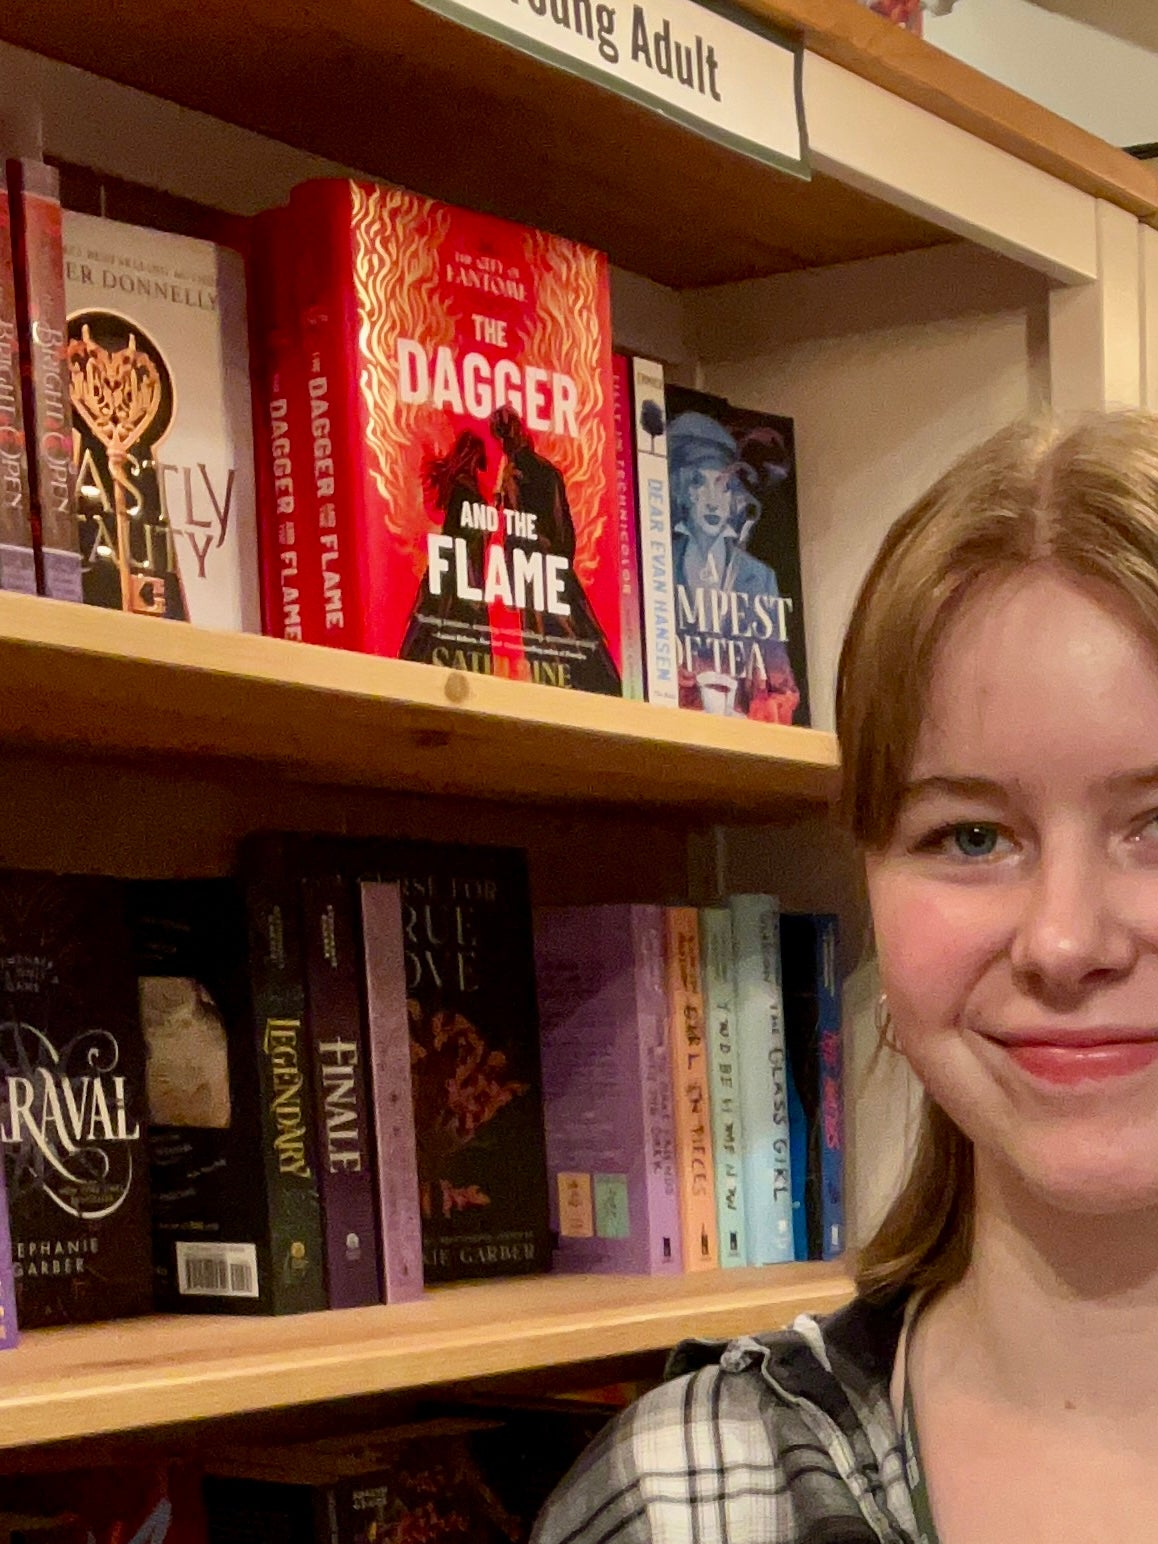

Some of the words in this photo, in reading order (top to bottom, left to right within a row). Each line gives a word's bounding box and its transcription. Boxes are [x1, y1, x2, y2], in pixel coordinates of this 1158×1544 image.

[631, 5, 722, 102] Adult
[103, 271, 219, 312] DONNELLY
[471, 313, 509, 348] THE
[396, 337, 580, 438] DAGGER
[269, 398, 296, 515] DAGGER
[308, 377, 335, 498] DAGGER
[460, 501, 501, 531] AND
[501, 507, 539, 542] THE
[647, 478, 665, 535] DEAR
[319, 534, 344, 630] FLAME
[427, 534, 572, 616] FLAME
[651, 541, 668, 593] EVAN
[652, 599, 672, 682] HANSEN
[676, 584, 793, 643] MPEST
[707, 638, 768, 681] TEA
[405, 904, 478, 946] RUE
[405, 950, 480, 992] OVE
[2, 1066, 140, 1160] RAVAL
[263, 1018, 313, 1179] LEGENDARY
[318, 1036, 363, 1174] FINALE
[769, 1048, 787, 1126] GLASS
[772, 1138, 788, 1202] GIRL
[17, 1236, 99, 1259] EPHANIE
